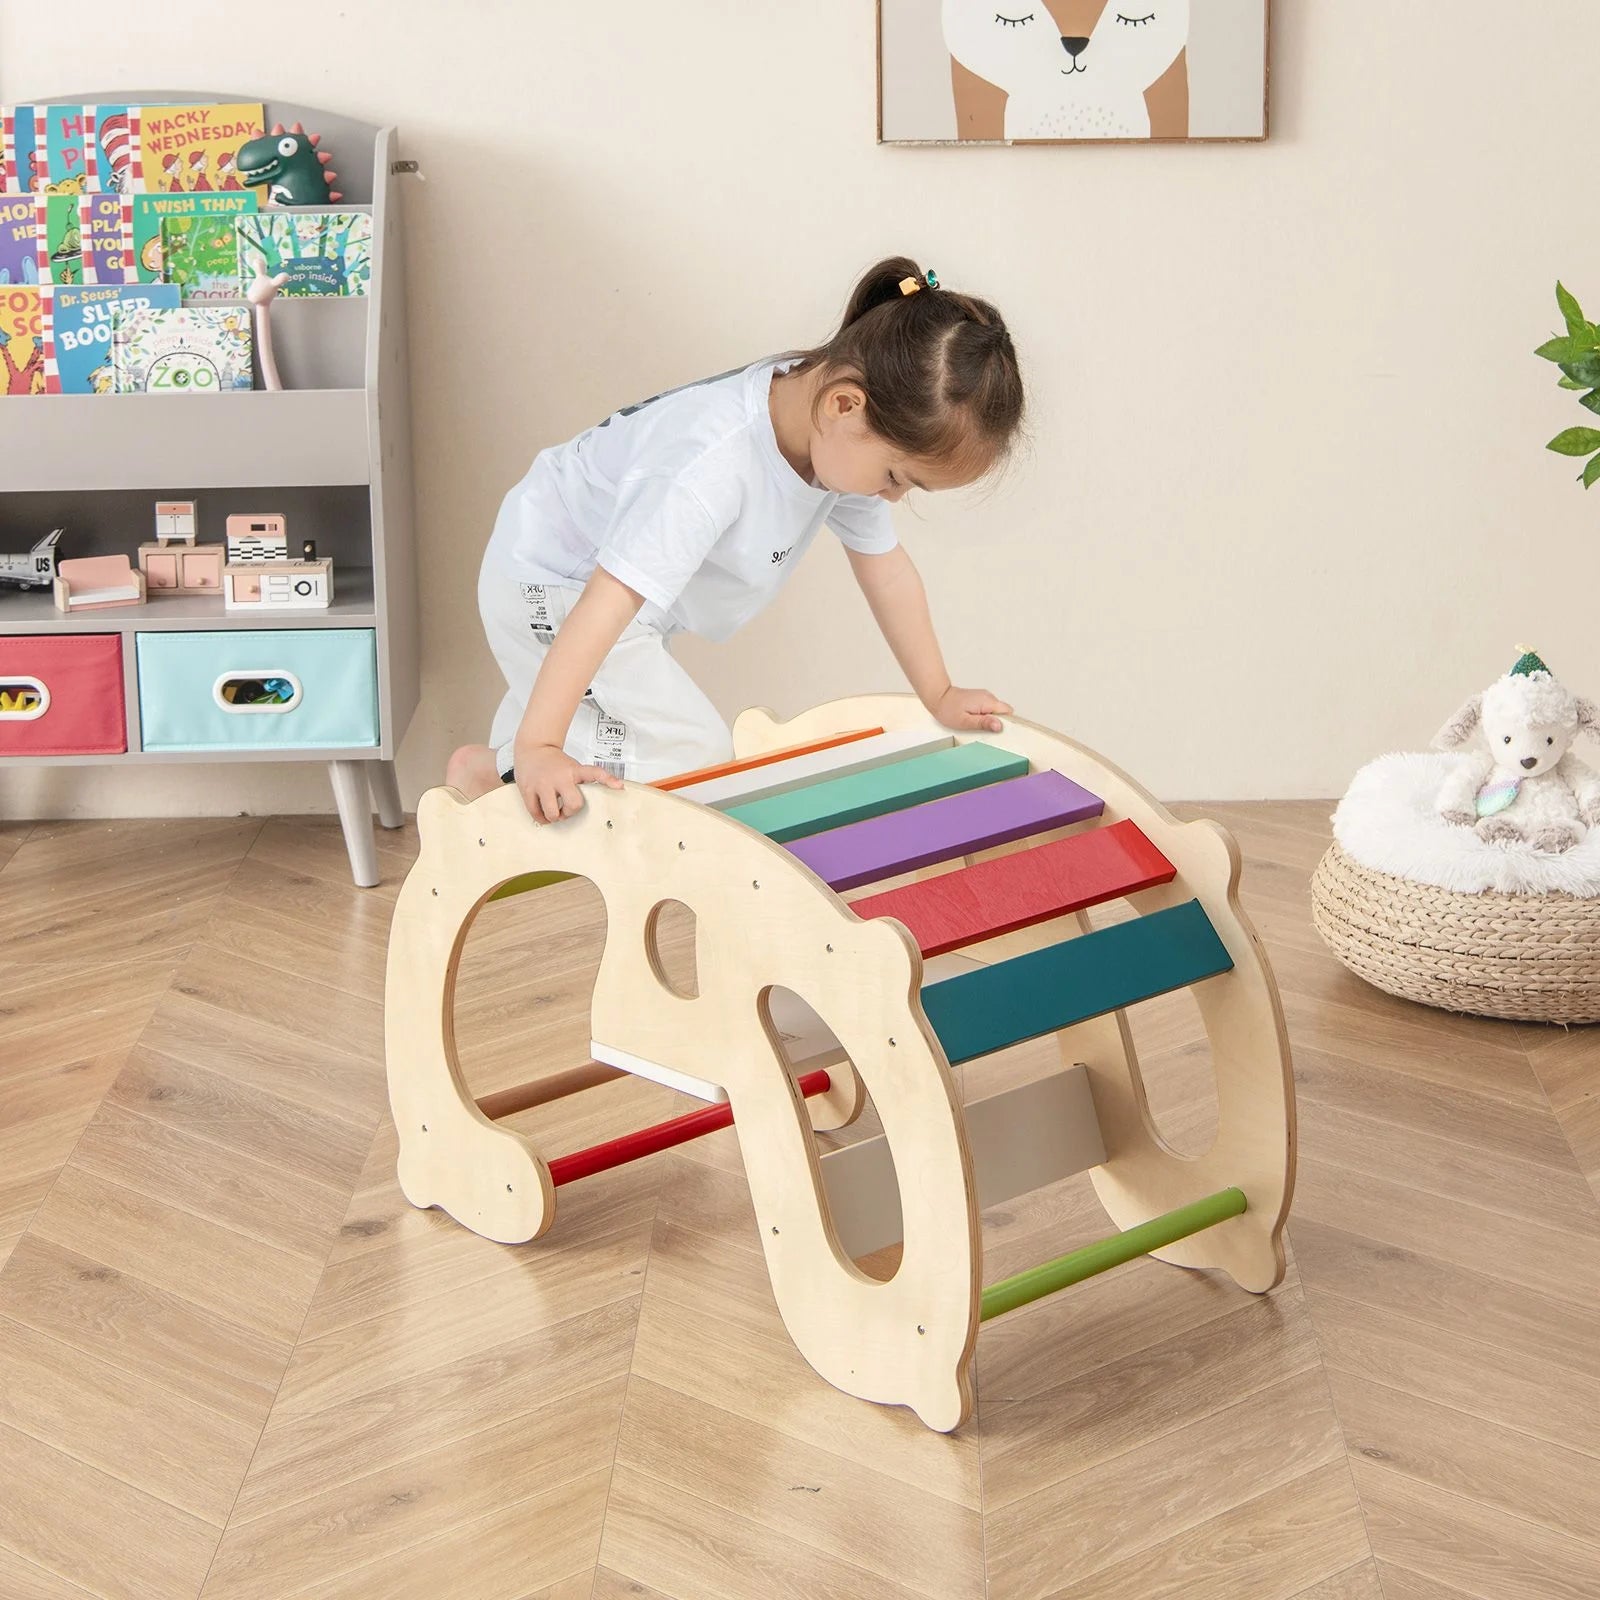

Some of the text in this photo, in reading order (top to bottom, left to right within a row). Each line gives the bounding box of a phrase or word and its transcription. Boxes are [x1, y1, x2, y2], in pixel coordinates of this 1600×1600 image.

[147, 110, 211, 135] WACKY
[147, 121, 256, 154] WEDNESDAY
[61, 148, 85, 171] P
[142, 198, 247, 214] I WISH THAT
[308, 270, 337, 285] inside
[59, 294, 80, 308] Dr.
[152, 366, 213, 388] ZOO
[36, 557, 50, 573] US
